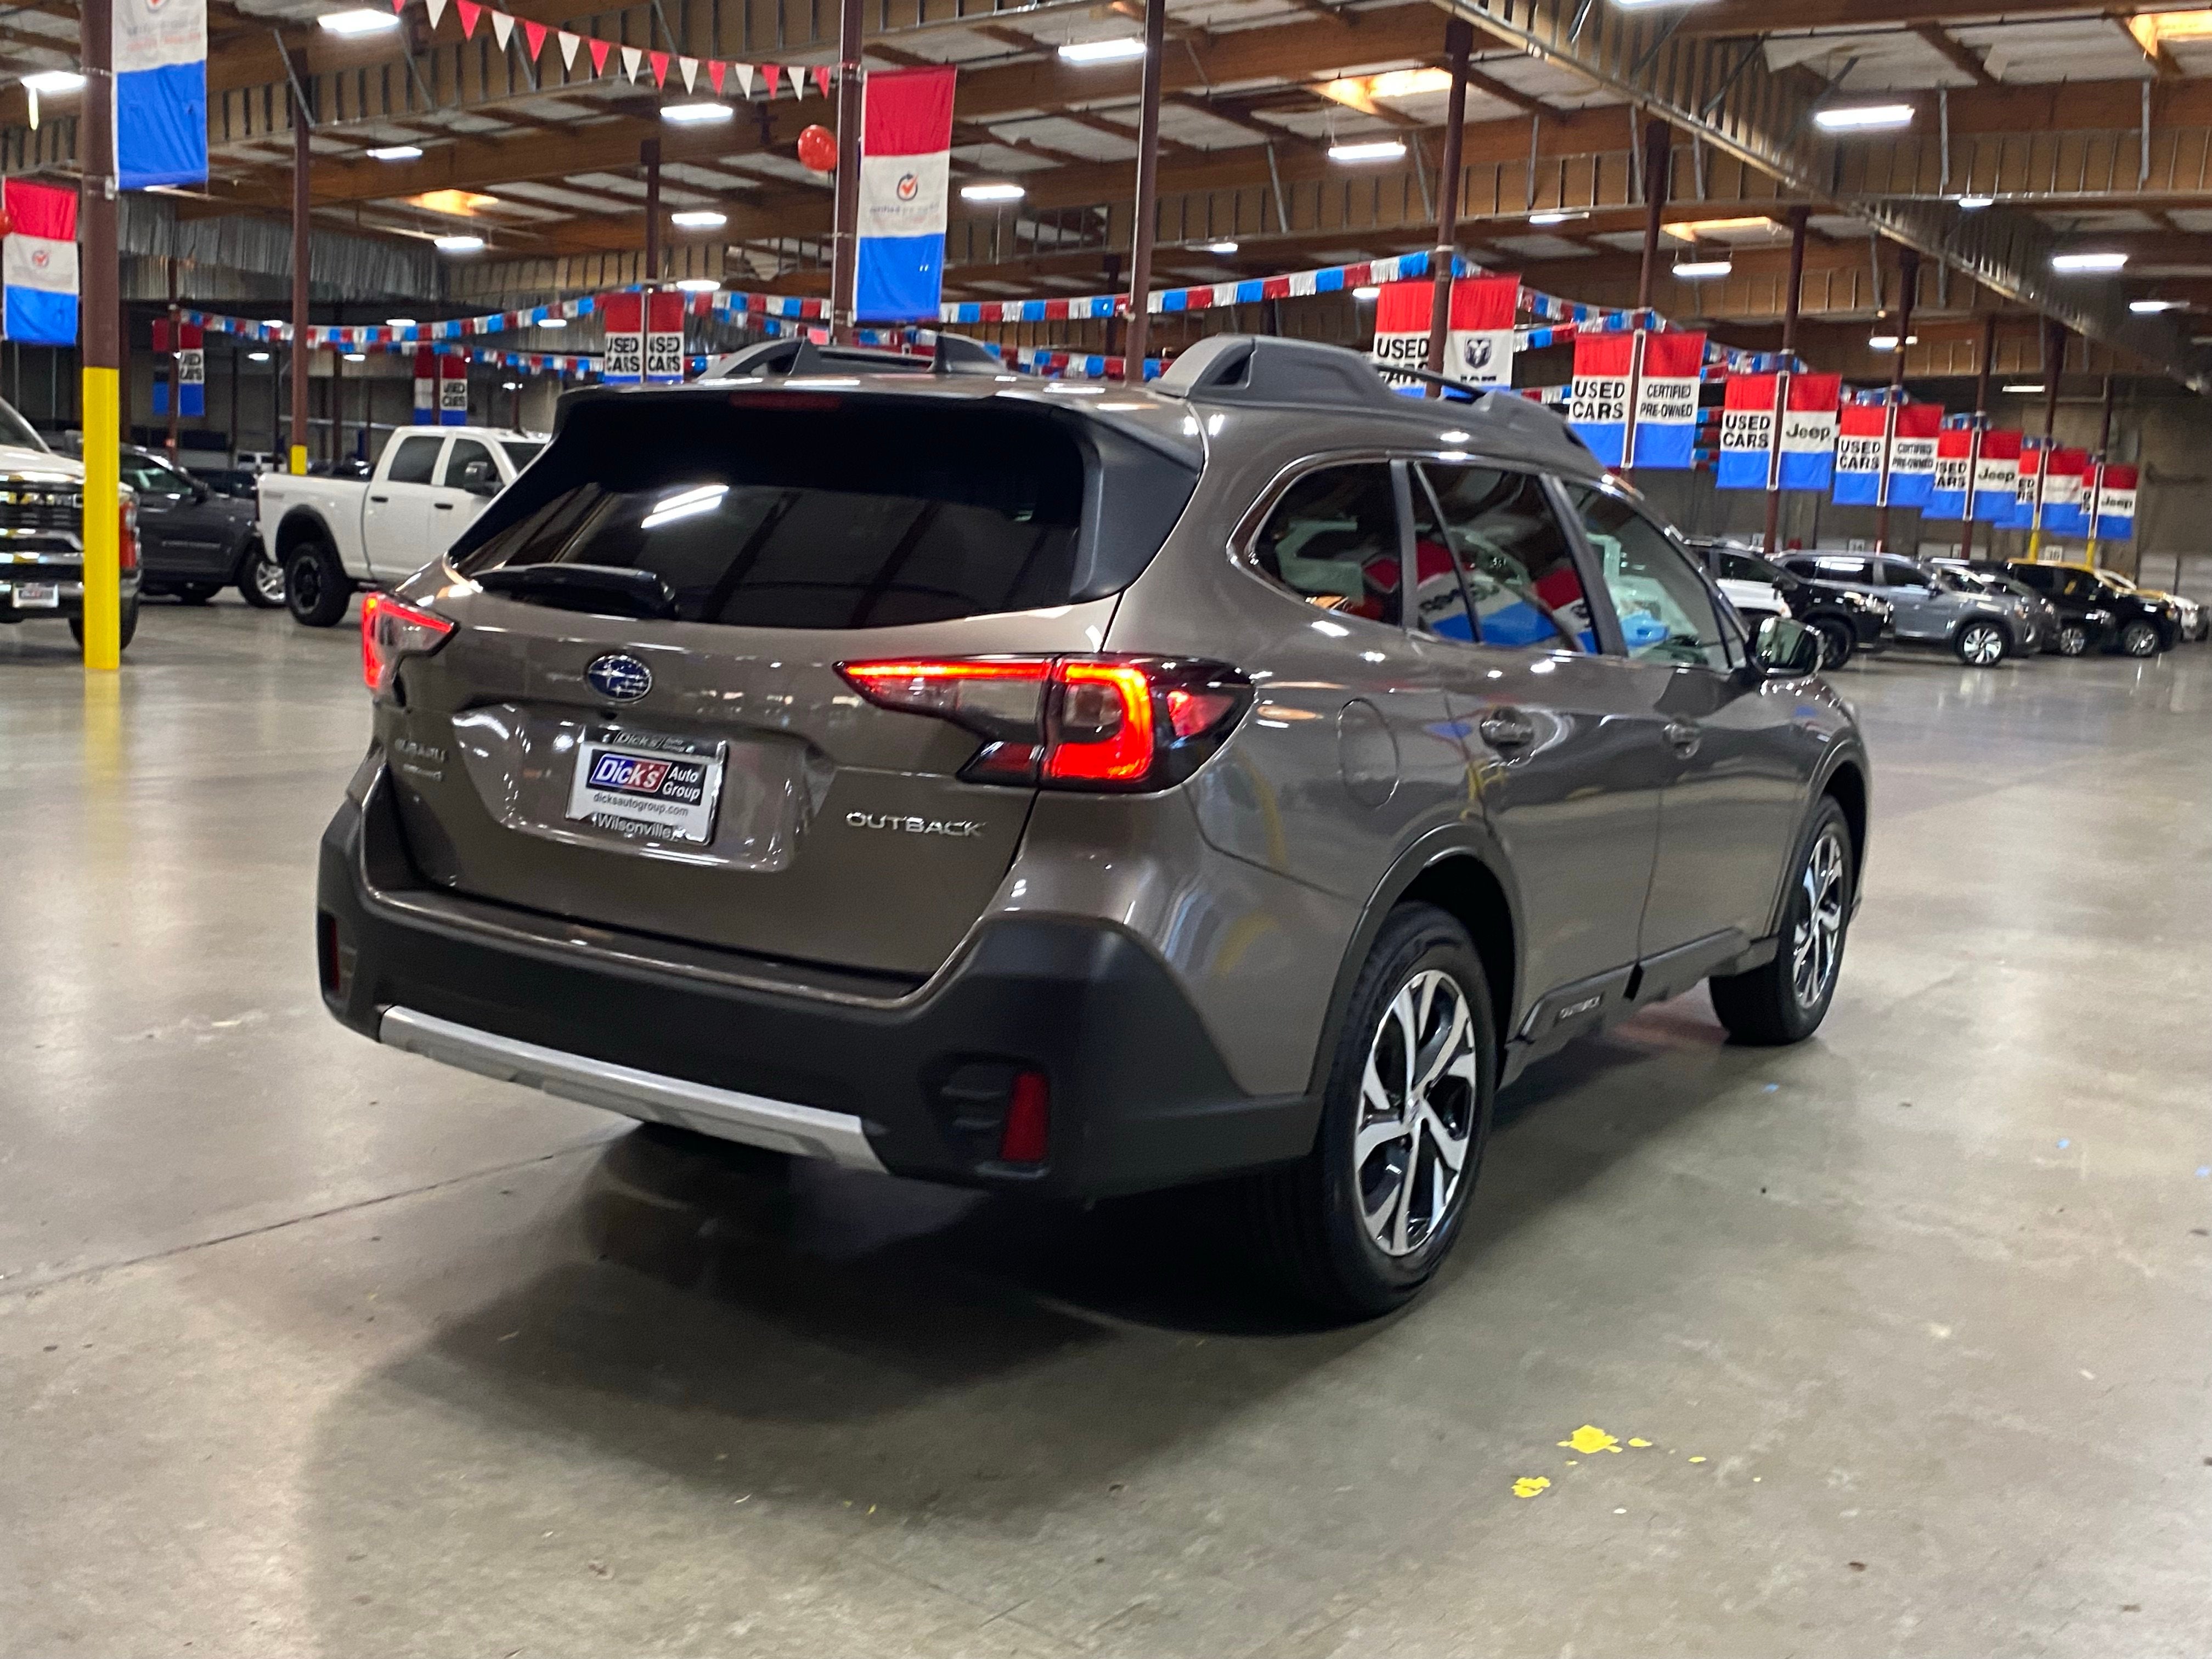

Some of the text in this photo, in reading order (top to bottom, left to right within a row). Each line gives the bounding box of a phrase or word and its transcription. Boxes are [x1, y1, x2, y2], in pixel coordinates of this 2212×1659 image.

[607, 337, 639, 353] USED
[650, 337, 680, 352] USED
[1377, 338, 1429, 358] USED
[607, 356, 640, 372] CARS
[648, 356, 681, 372] CARS
[1574, 381, 1625, 398] USED
[1646, 384, 1691, 399] CERTIFIED
[1572, 401, 1624, 420] CARS
[1640, 403, 1693, 417] PRE-OWNED
[1725, 415, 1771, 431] USED
[1723, 432, 1769, 448] CARS
[1786, 423, 1831, 441] Jeep
[1841, 439, 1881, 454] USED
[1839, 455, 1879, 470] CARS
[1936, 461, 1967, 474] SED
[1937, 476, 1965, 488] ARS
[1978, 467, 2015, 483] Jeep
[595, 759, 661, 789] Dick's
[668, 765, 699, 783] Auto
[662, 781, 701, 801] Group
[593, 792, 689, 816] dicksautogroup.com
[597, 813, 672, 839] Wilsonville
[845, 811, 986, 836] OUTBACK
